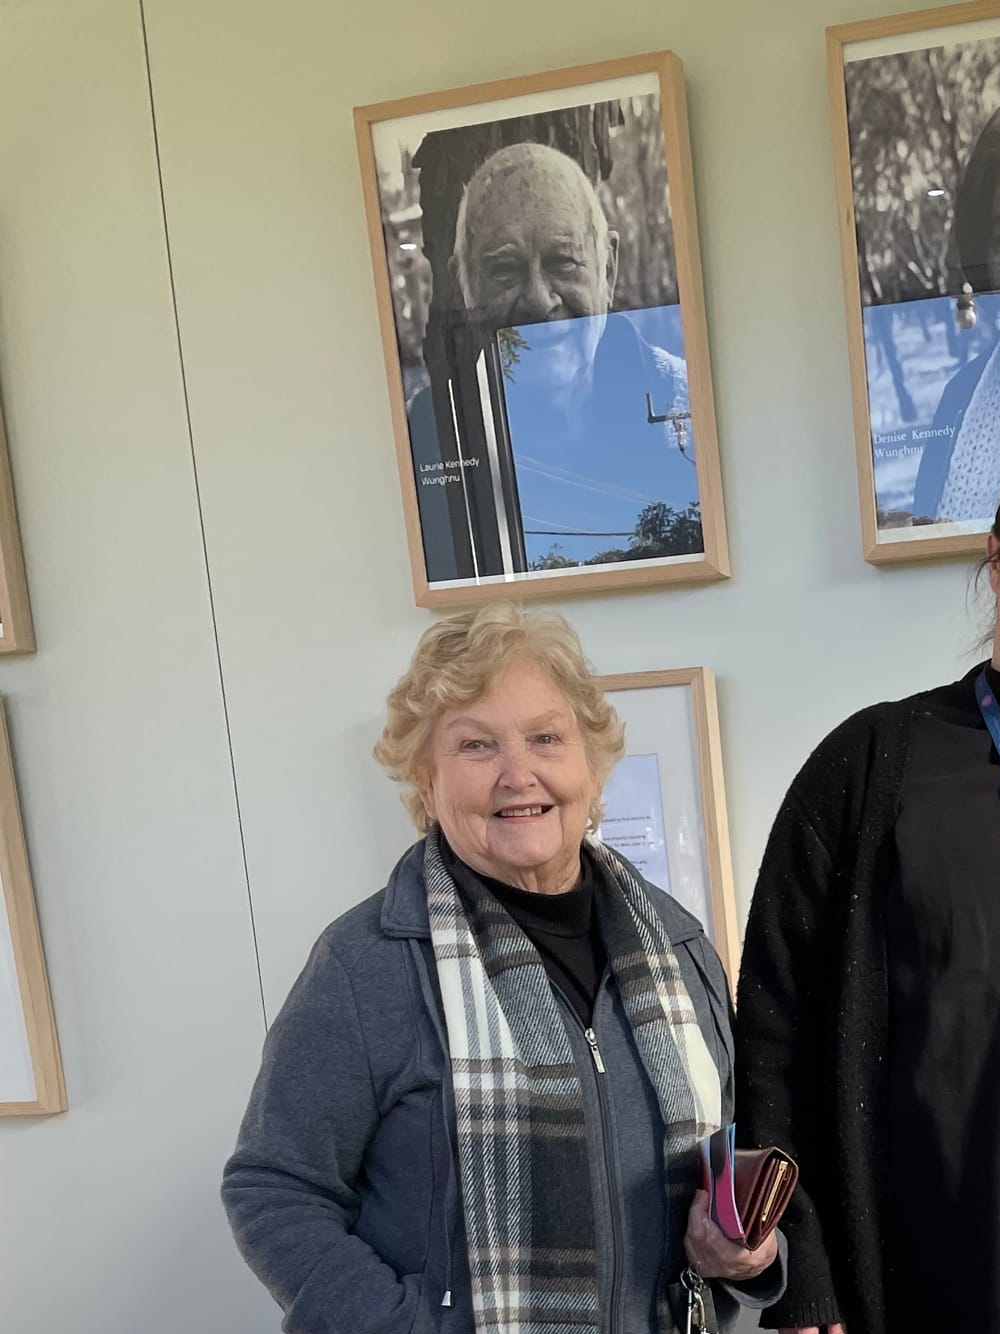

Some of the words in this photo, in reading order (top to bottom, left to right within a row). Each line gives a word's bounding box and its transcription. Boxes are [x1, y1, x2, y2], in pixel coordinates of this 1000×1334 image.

[873, 432, 907, 444] Denise
[911, 425, 956, 440] Kennedy
[420, 461, 444, 472] Laurie
